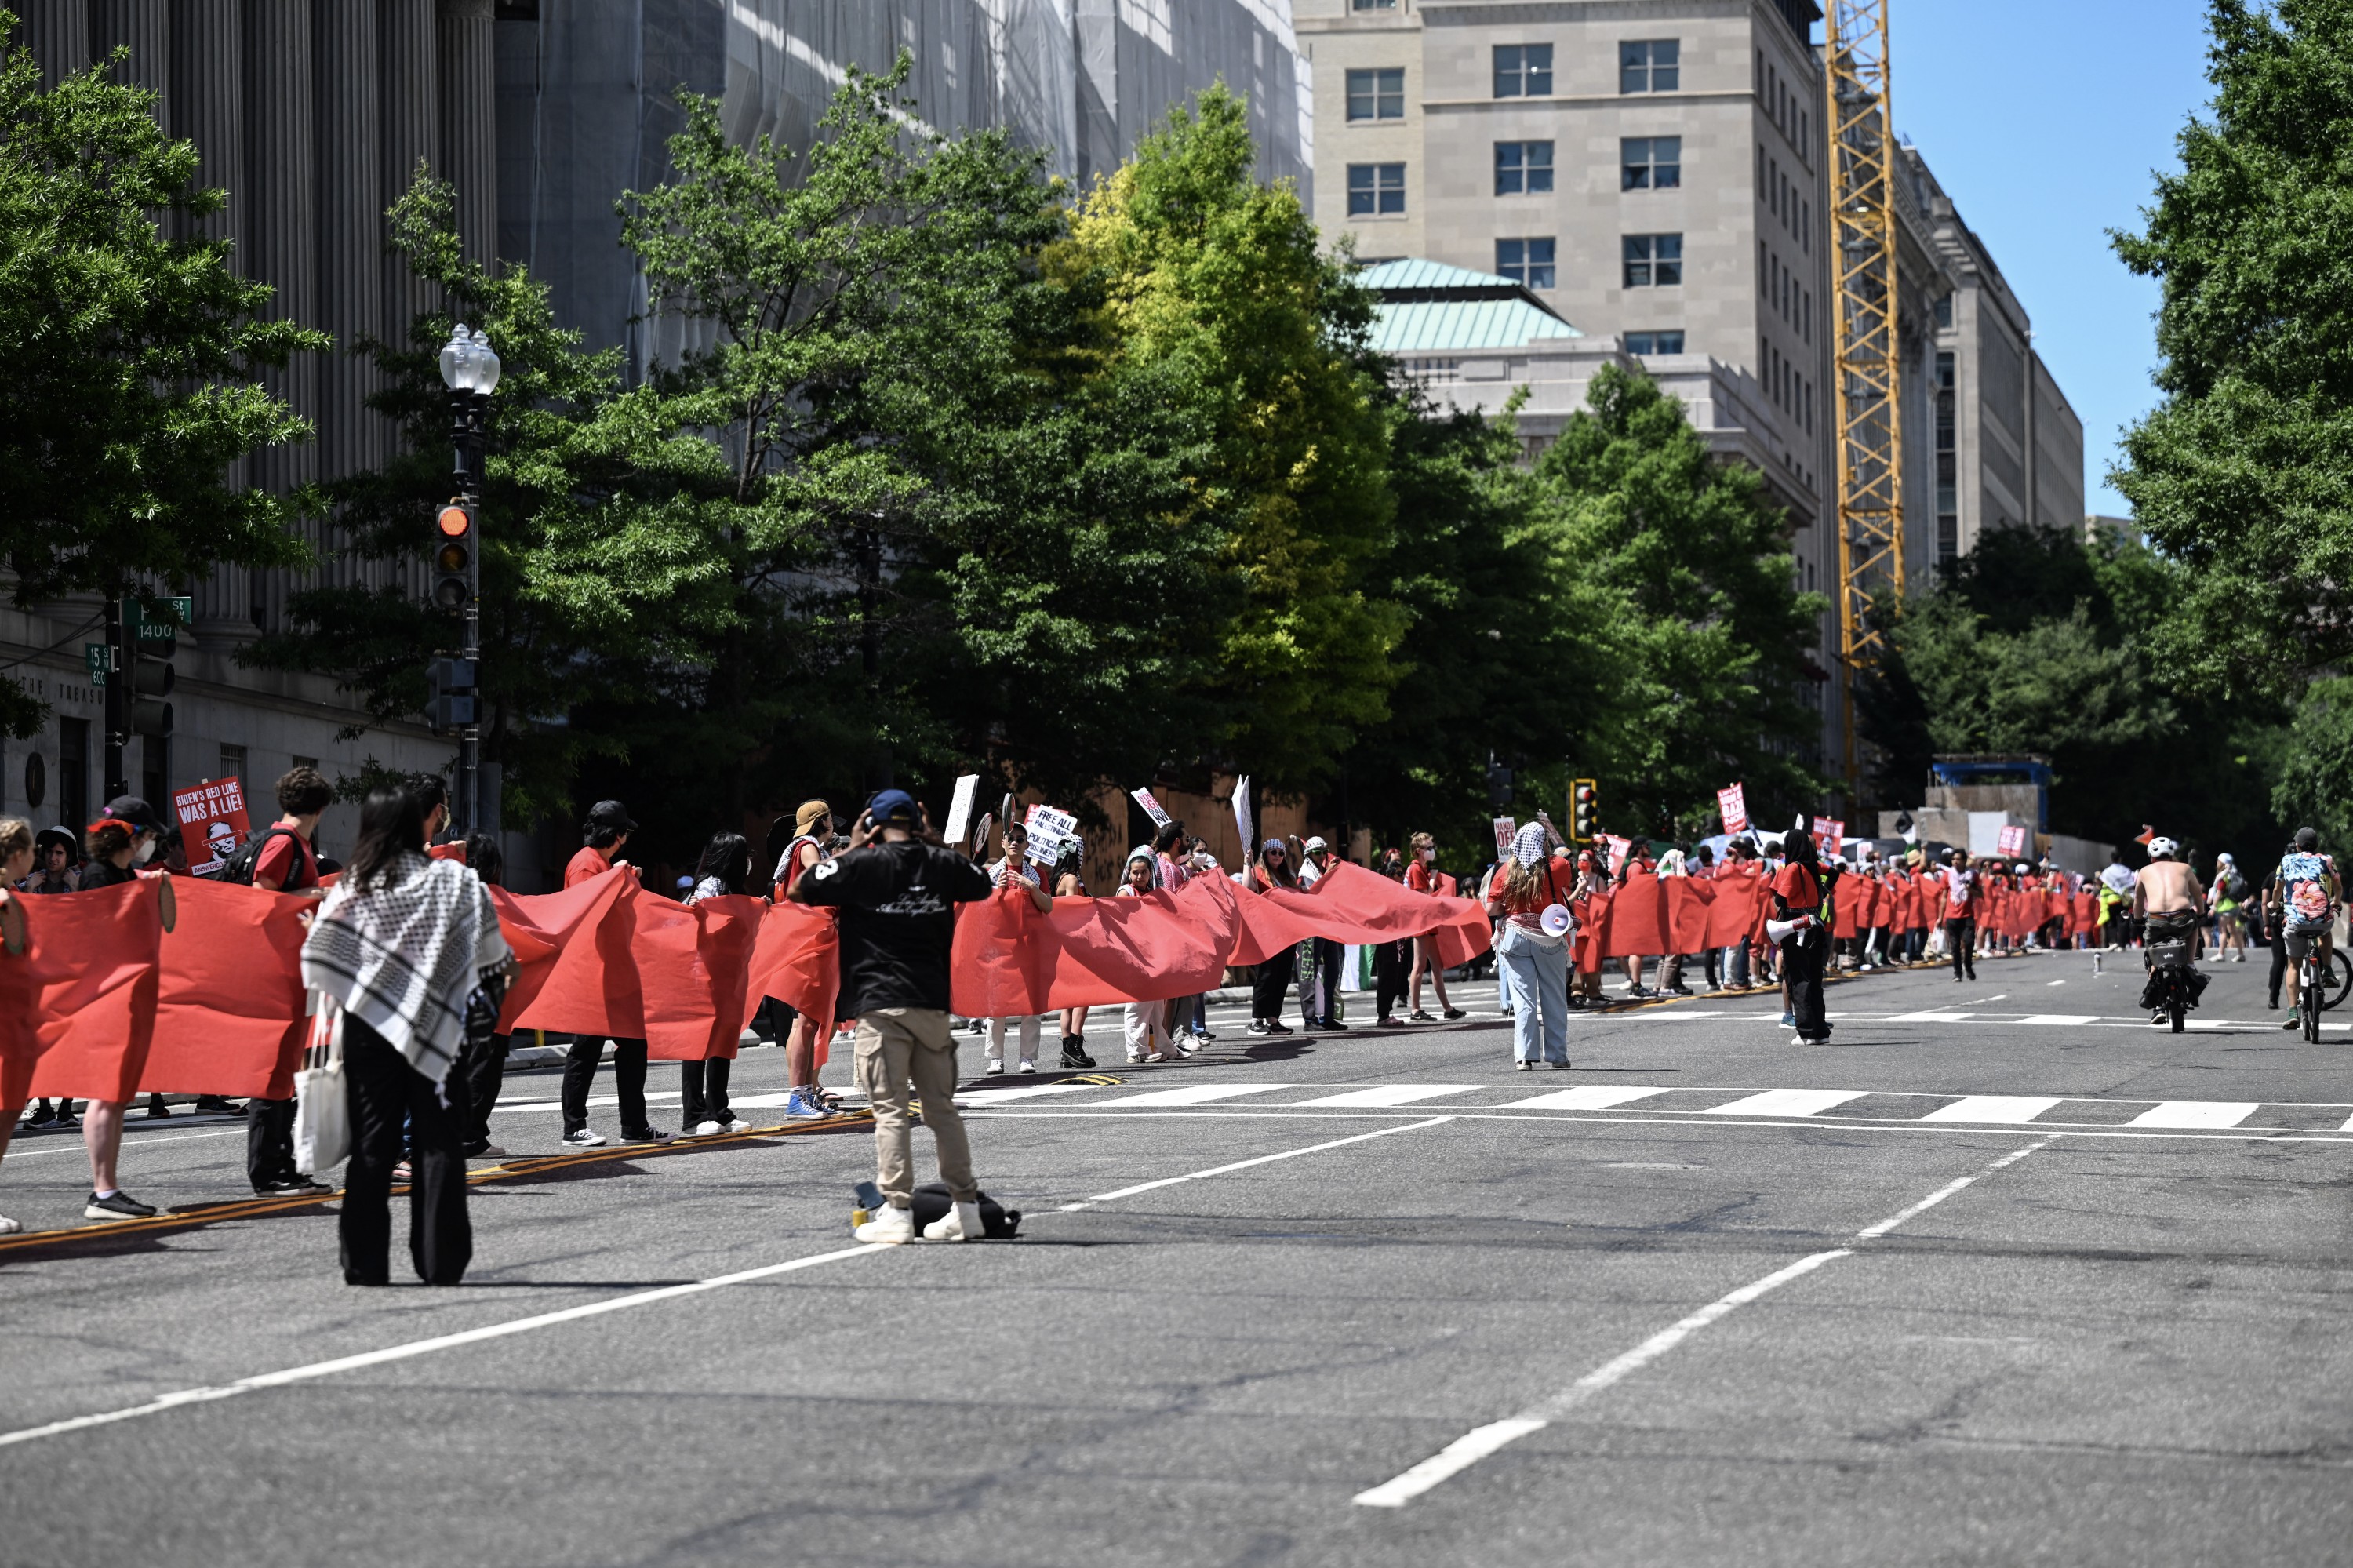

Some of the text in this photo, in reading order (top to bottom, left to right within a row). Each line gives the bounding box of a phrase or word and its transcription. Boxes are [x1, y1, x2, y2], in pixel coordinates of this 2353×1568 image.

[172, 600, 184, 610] St
[140, 624, 172, 638] 1400
[91, 647, 100, 667] 15
[21, 676, 43, 695] THE
[93, 671, 105, 685] 600
[176, 781, 239, 806] BIDEN'S RED LINE
[178, 794, 243, 824] WAS A LIE!
[1038, 809, 1058, 824] FREE
[1057, 818, 1071, 831] ALL
[1495, 820, 1515, 831] HANDS
[1497, 831, 1515, 847] OFF
